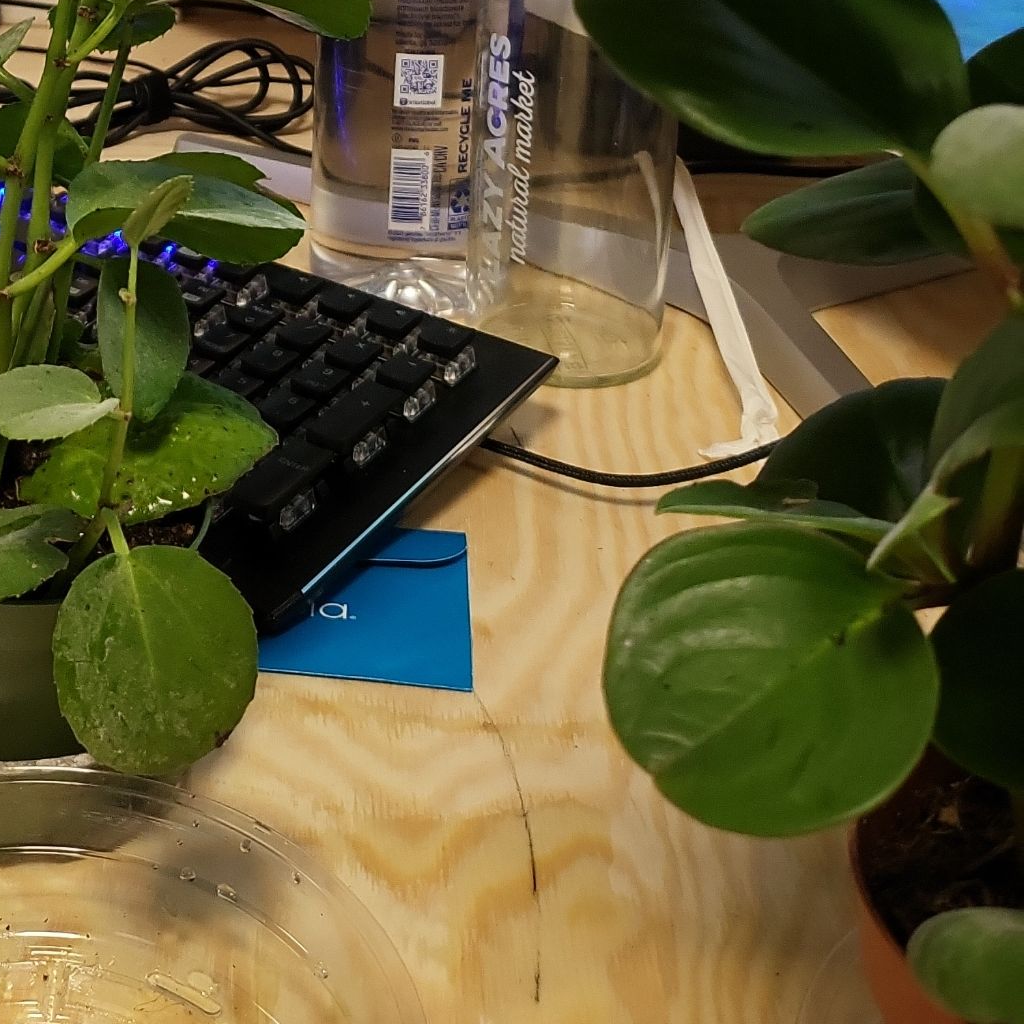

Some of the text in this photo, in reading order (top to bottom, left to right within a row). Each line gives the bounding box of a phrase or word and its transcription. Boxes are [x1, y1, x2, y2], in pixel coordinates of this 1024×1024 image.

[458, 78, 473, 173] RECYCLE ME
[484, 32, 511, 170] ACRES
[505, 70, 535, 264] natural market
